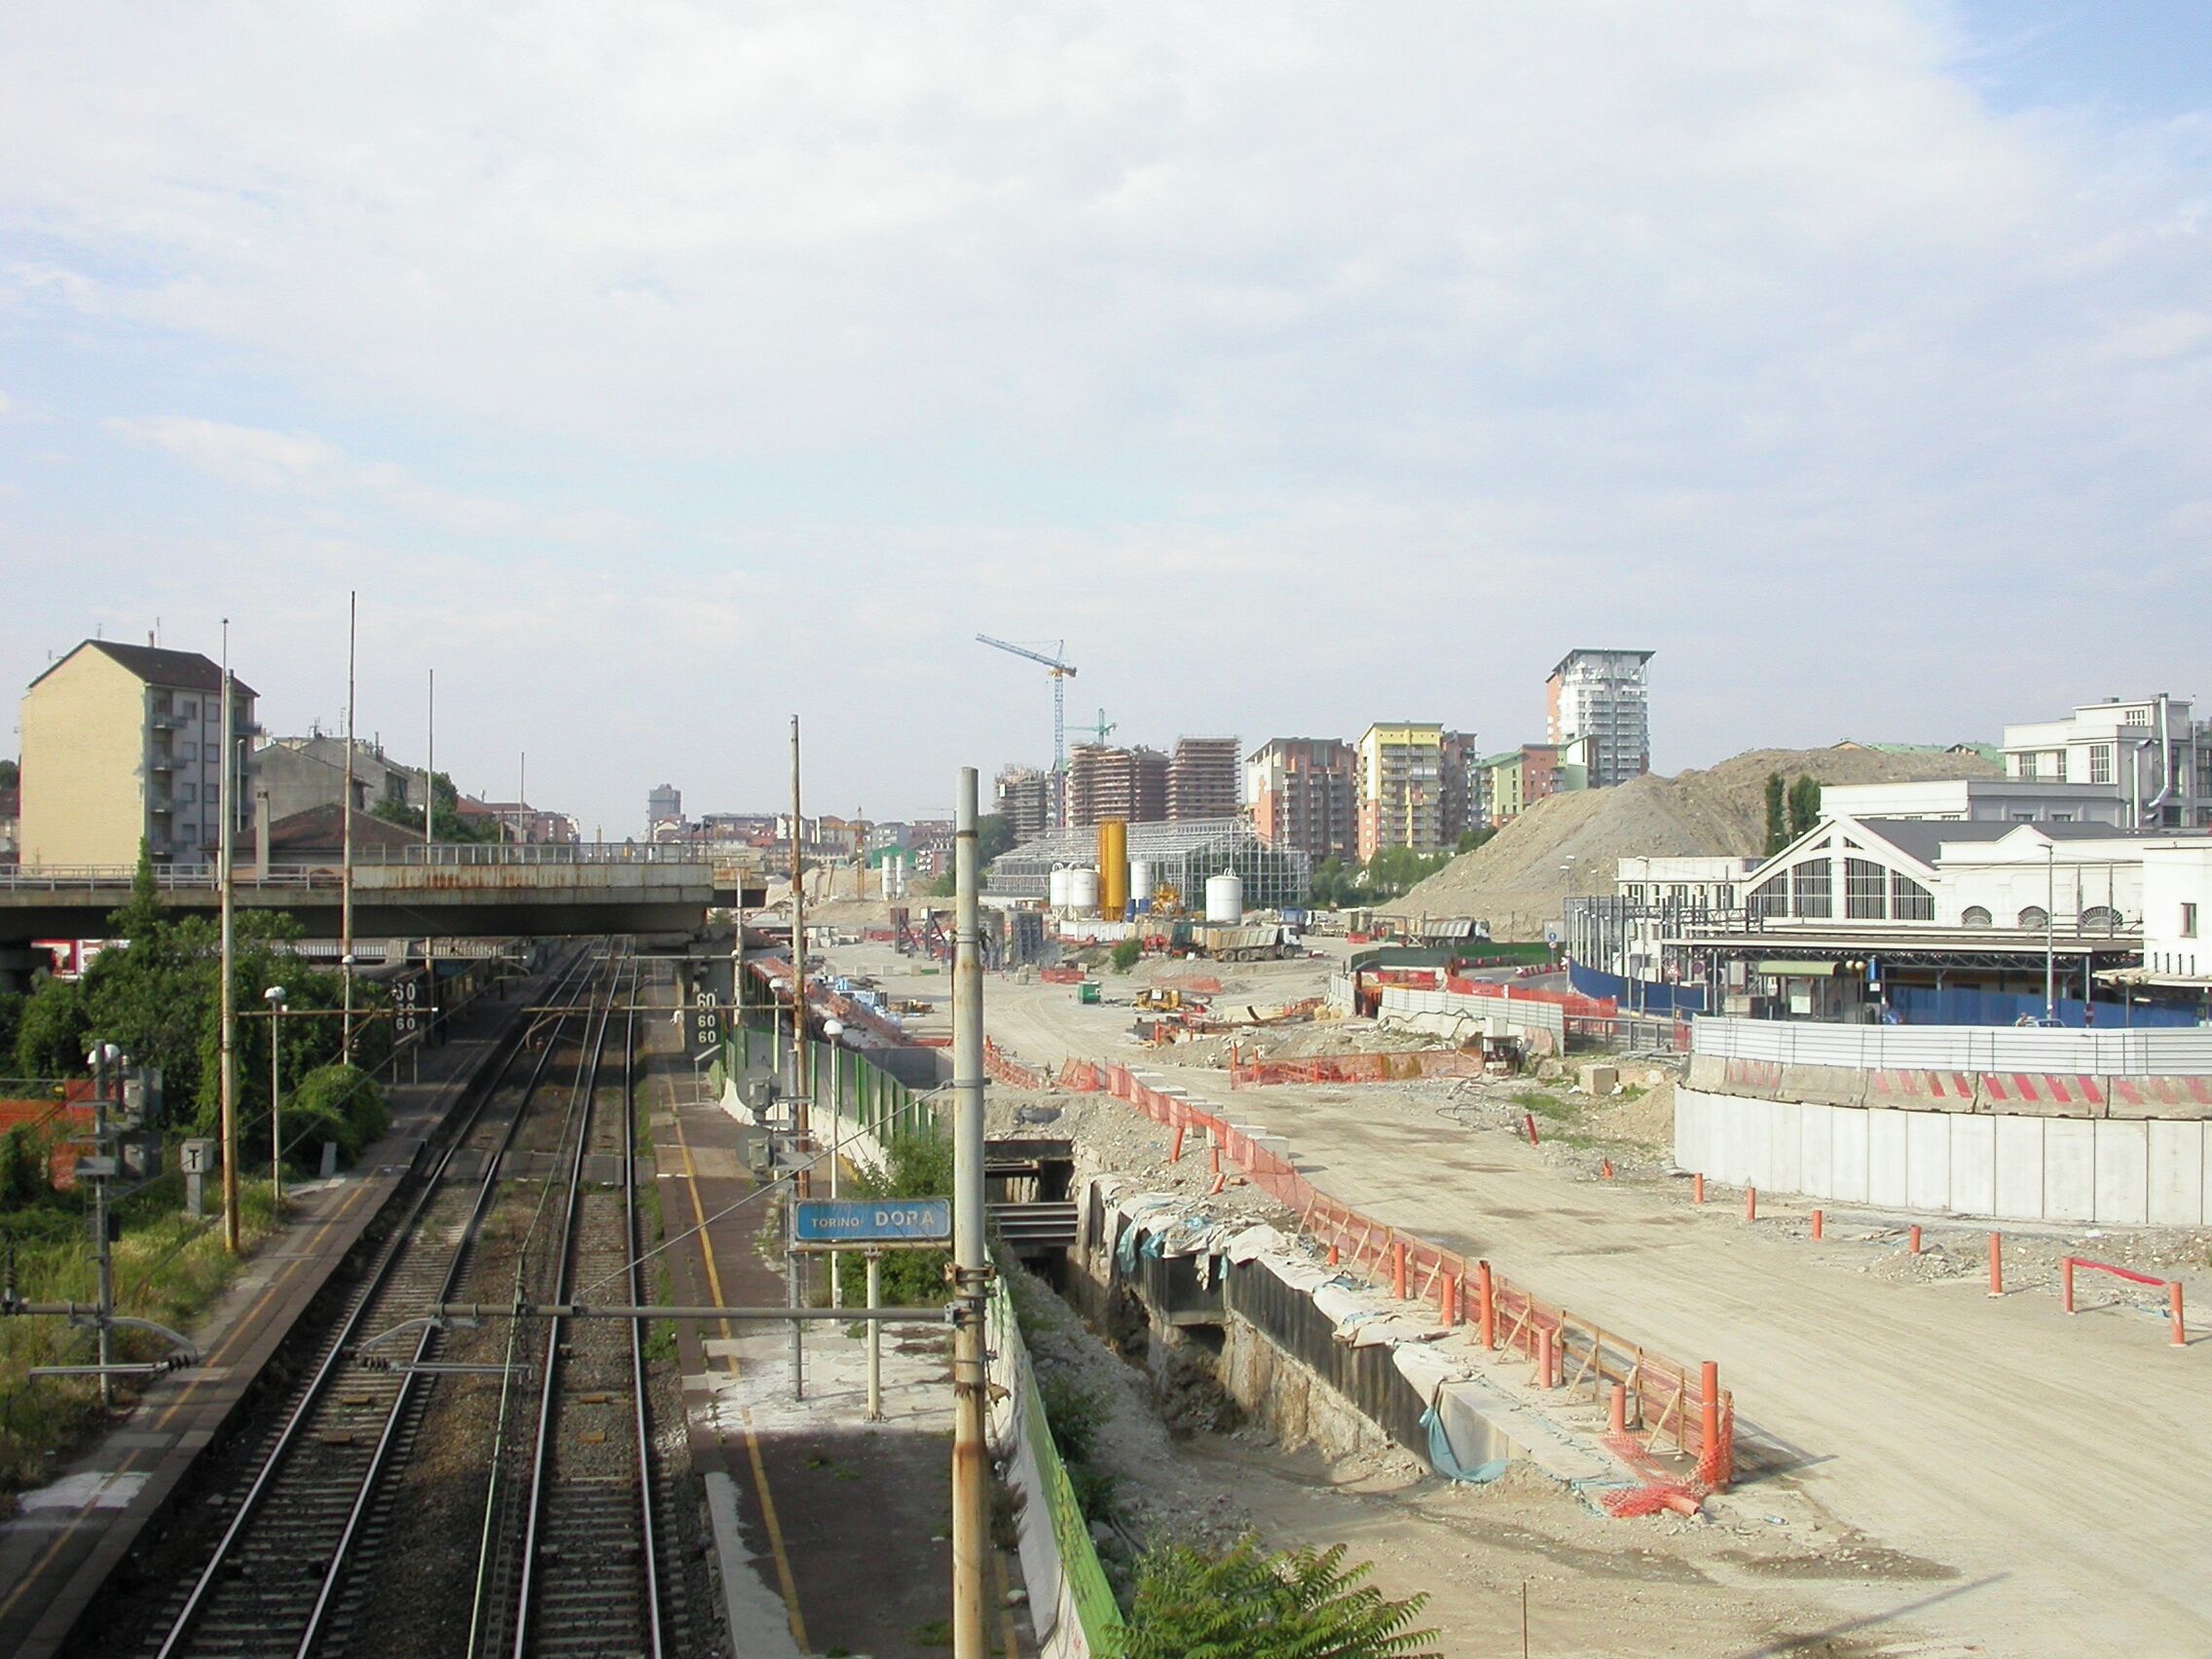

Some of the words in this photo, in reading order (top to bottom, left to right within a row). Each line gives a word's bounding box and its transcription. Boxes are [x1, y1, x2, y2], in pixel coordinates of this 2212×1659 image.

[697, 992, 716, 1012] 60
[395, 1017, 416, 1030] 60
[698, 1014, 716, 1027] 60
[698, 1030, 717, 1043] 60
[188, 1150, 200, 1169] T
[811, 1216, 859, 1228] TORINO
